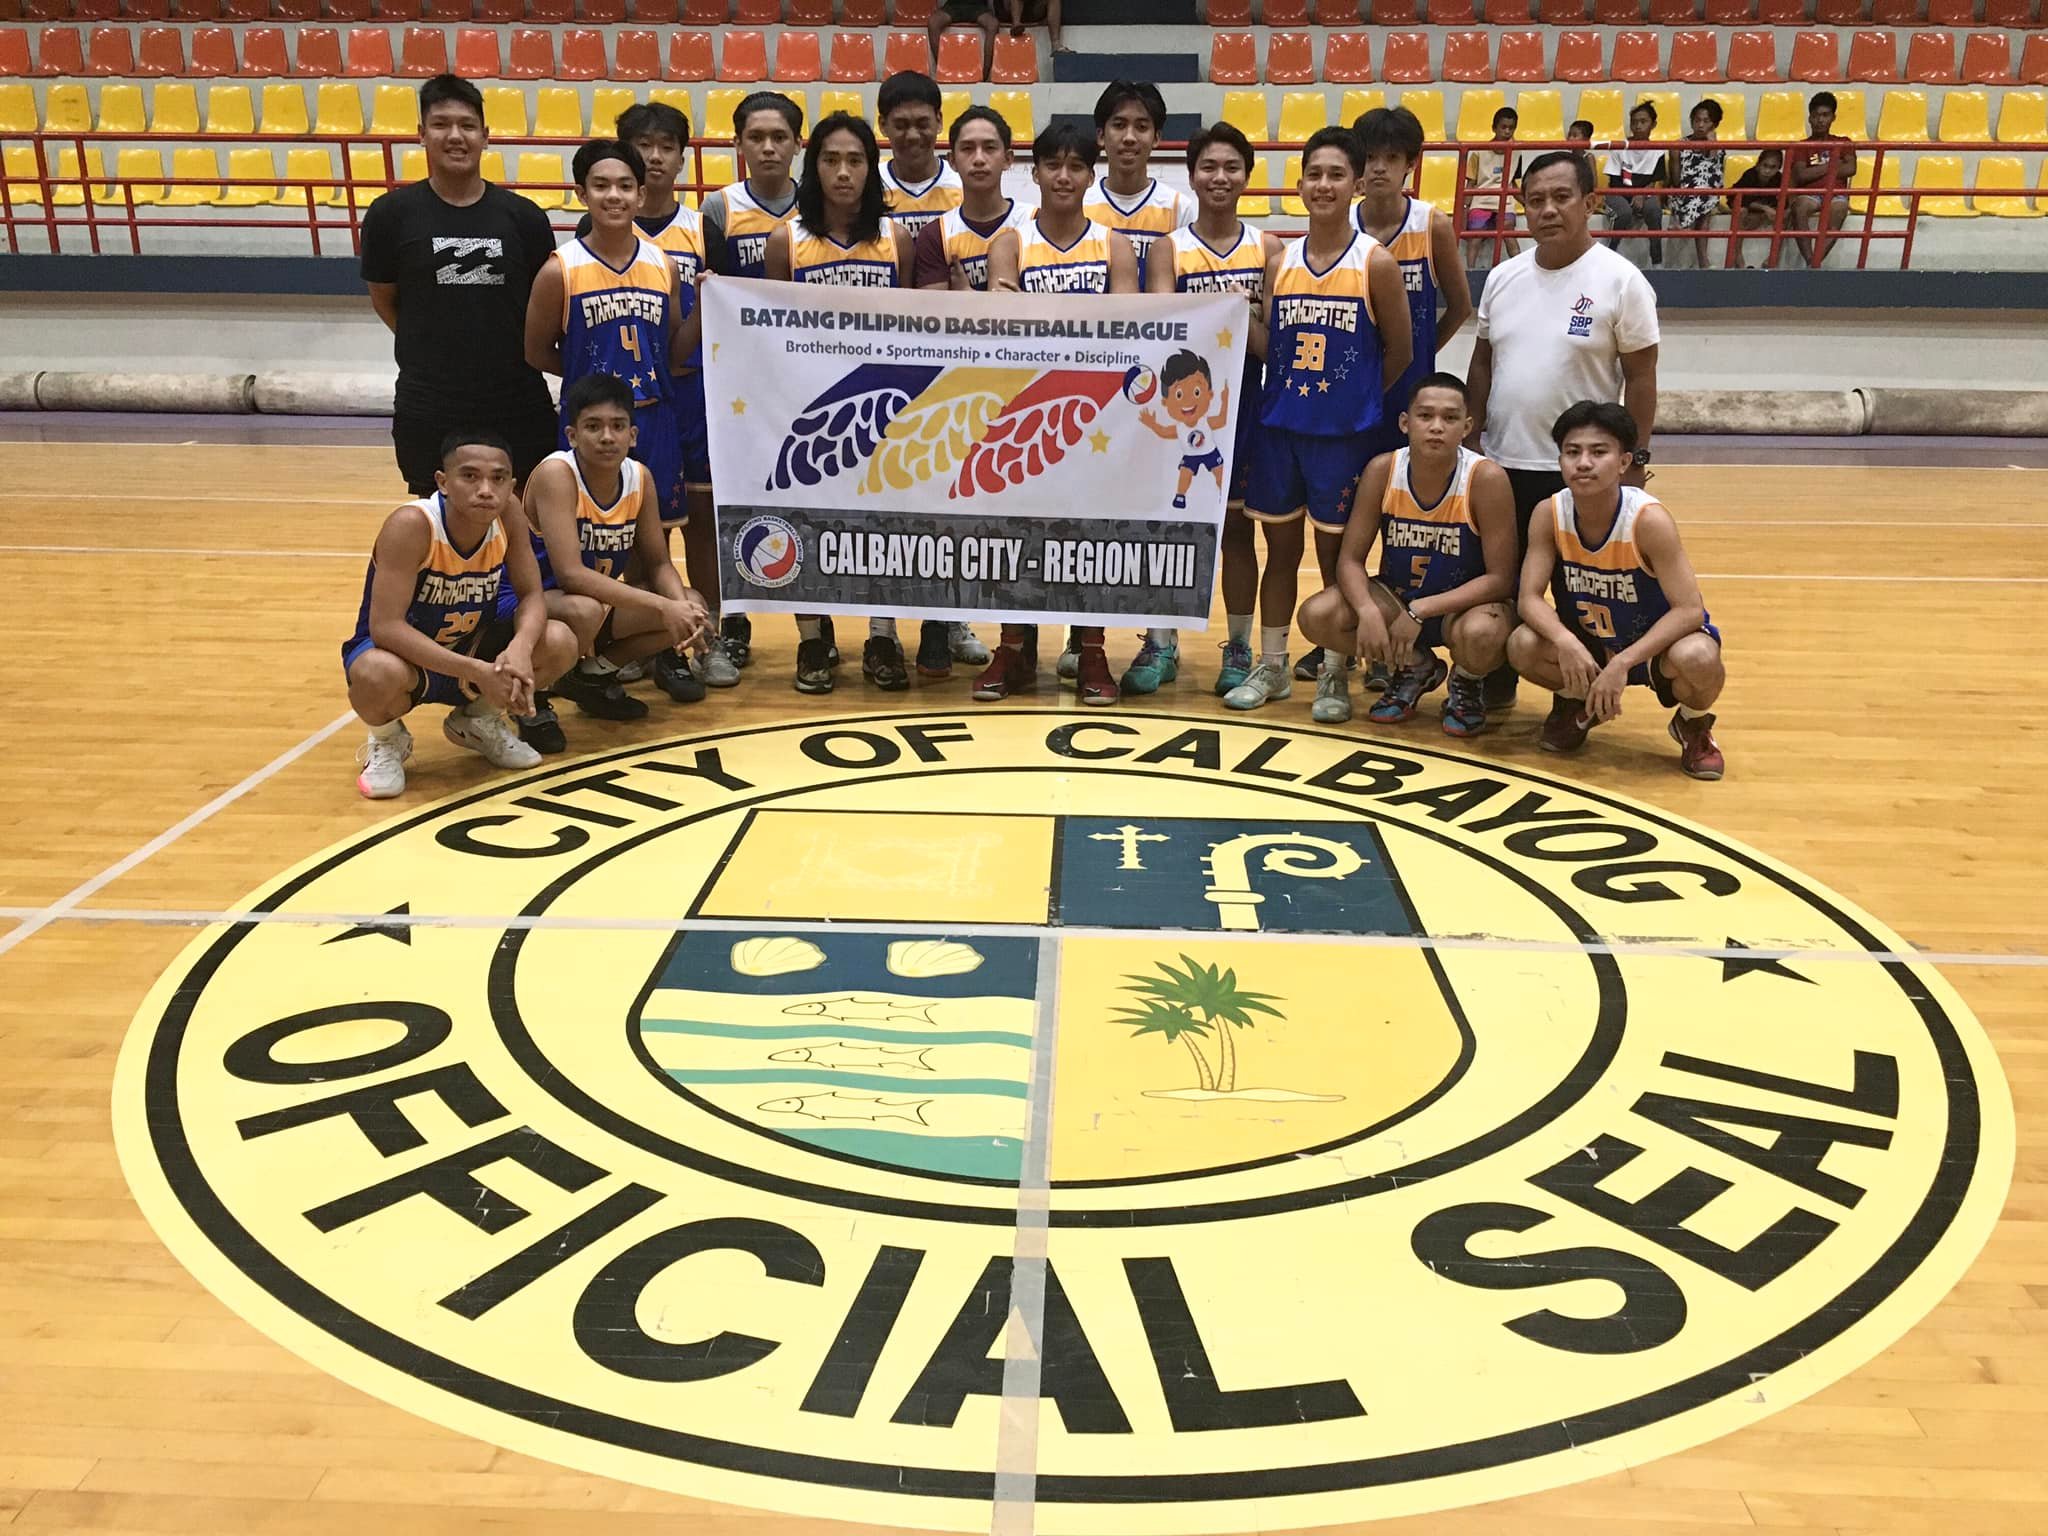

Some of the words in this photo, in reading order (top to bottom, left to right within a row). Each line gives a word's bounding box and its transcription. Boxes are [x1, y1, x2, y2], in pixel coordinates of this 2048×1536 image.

[740, 307, 835, 330] BATANG
[839, 312, 940, 334] PILIPINO
[945, 317, 1093, 339] BASKETBALL
[1097, 320, 1188, 341] LEAGUE
[1278, 299, 1358, 333] STARHOOPSTERS
[1570, 315, 1593, 328] SBP
[620, 324, 642, 361] 4
[786, 340, 872, 356] Brotherhood
[886, 344, 980, 362] Sportmanship
[995, 348, 1060, 362] Character
[1075, 351, 1140, 367] Discipline
[1292, 331, 1326, 371] 38
[819, 531, 954, 579] CALBAYOG
[961, 536, 1023, 581] CITY
[1043, 539, 1142, 585] REGION
[1147, 543, 1195, 587] VIII
[1410, 555, 1432, 589] 5
[1576, 600, 1616, 638] 20
[435, 748, 755, 859] CITY
[800, 722, 974, 769] OF
[1045, 721, 1742, 904] CALBAYOG
[223, 1000, 1368, 1434] OFFICIAL
[1410, 1049, 1900, 1355] SEAL
